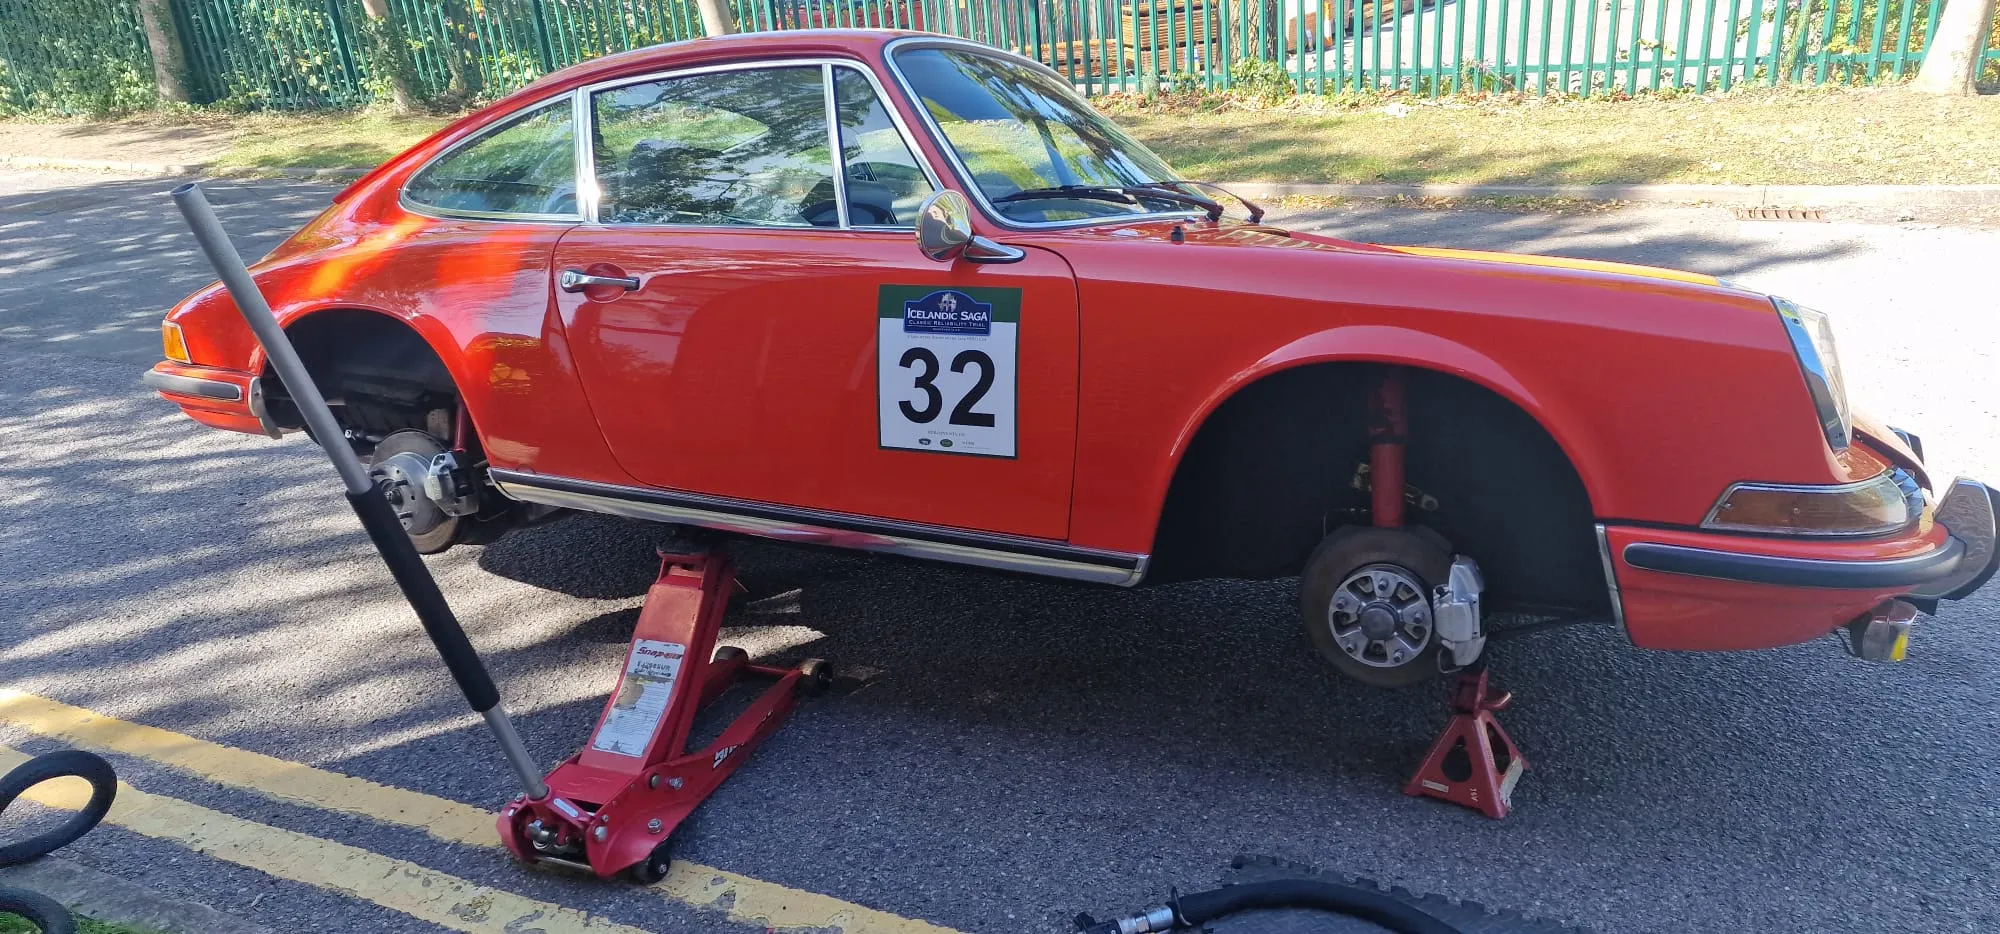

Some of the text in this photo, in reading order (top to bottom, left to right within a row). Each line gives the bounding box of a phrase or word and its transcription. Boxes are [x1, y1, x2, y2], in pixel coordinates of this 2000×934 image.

[907, 307, 988, 321] ICELANDIC SAGA
[898, 347, 995, 427] 32
